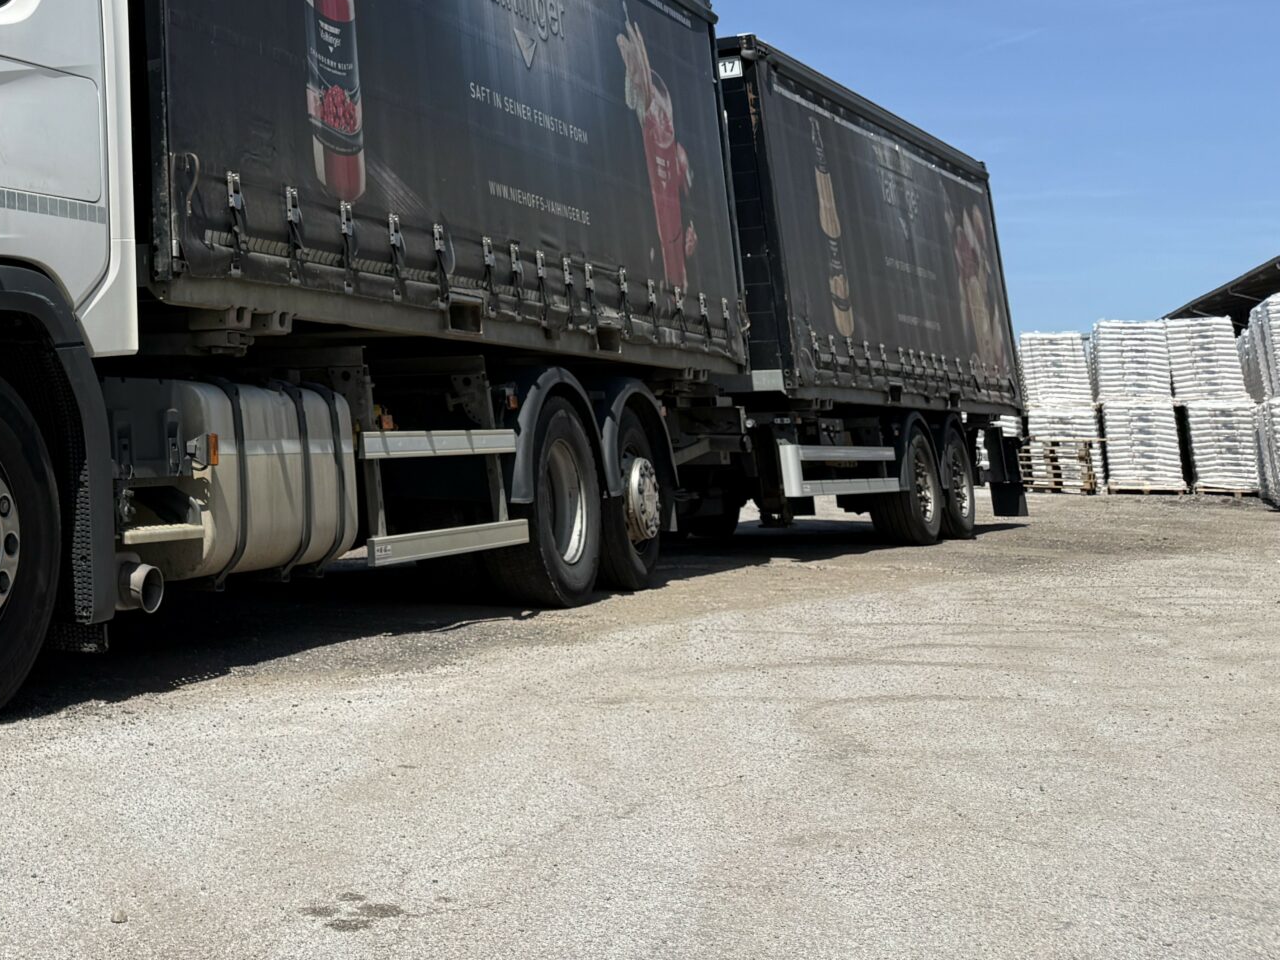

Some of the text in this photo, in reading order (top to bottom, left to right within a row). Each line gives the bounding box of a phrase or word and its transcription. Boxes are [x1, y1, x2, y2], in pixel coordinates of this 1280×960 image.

[721, 61, 735, 73] 17
[469, 82, 588, 144] SAFT IN SEINER FEINSTEN FORM
[488, 180, 591, 225] WWW.NIEHOFFS-VAIHINGER.DE
